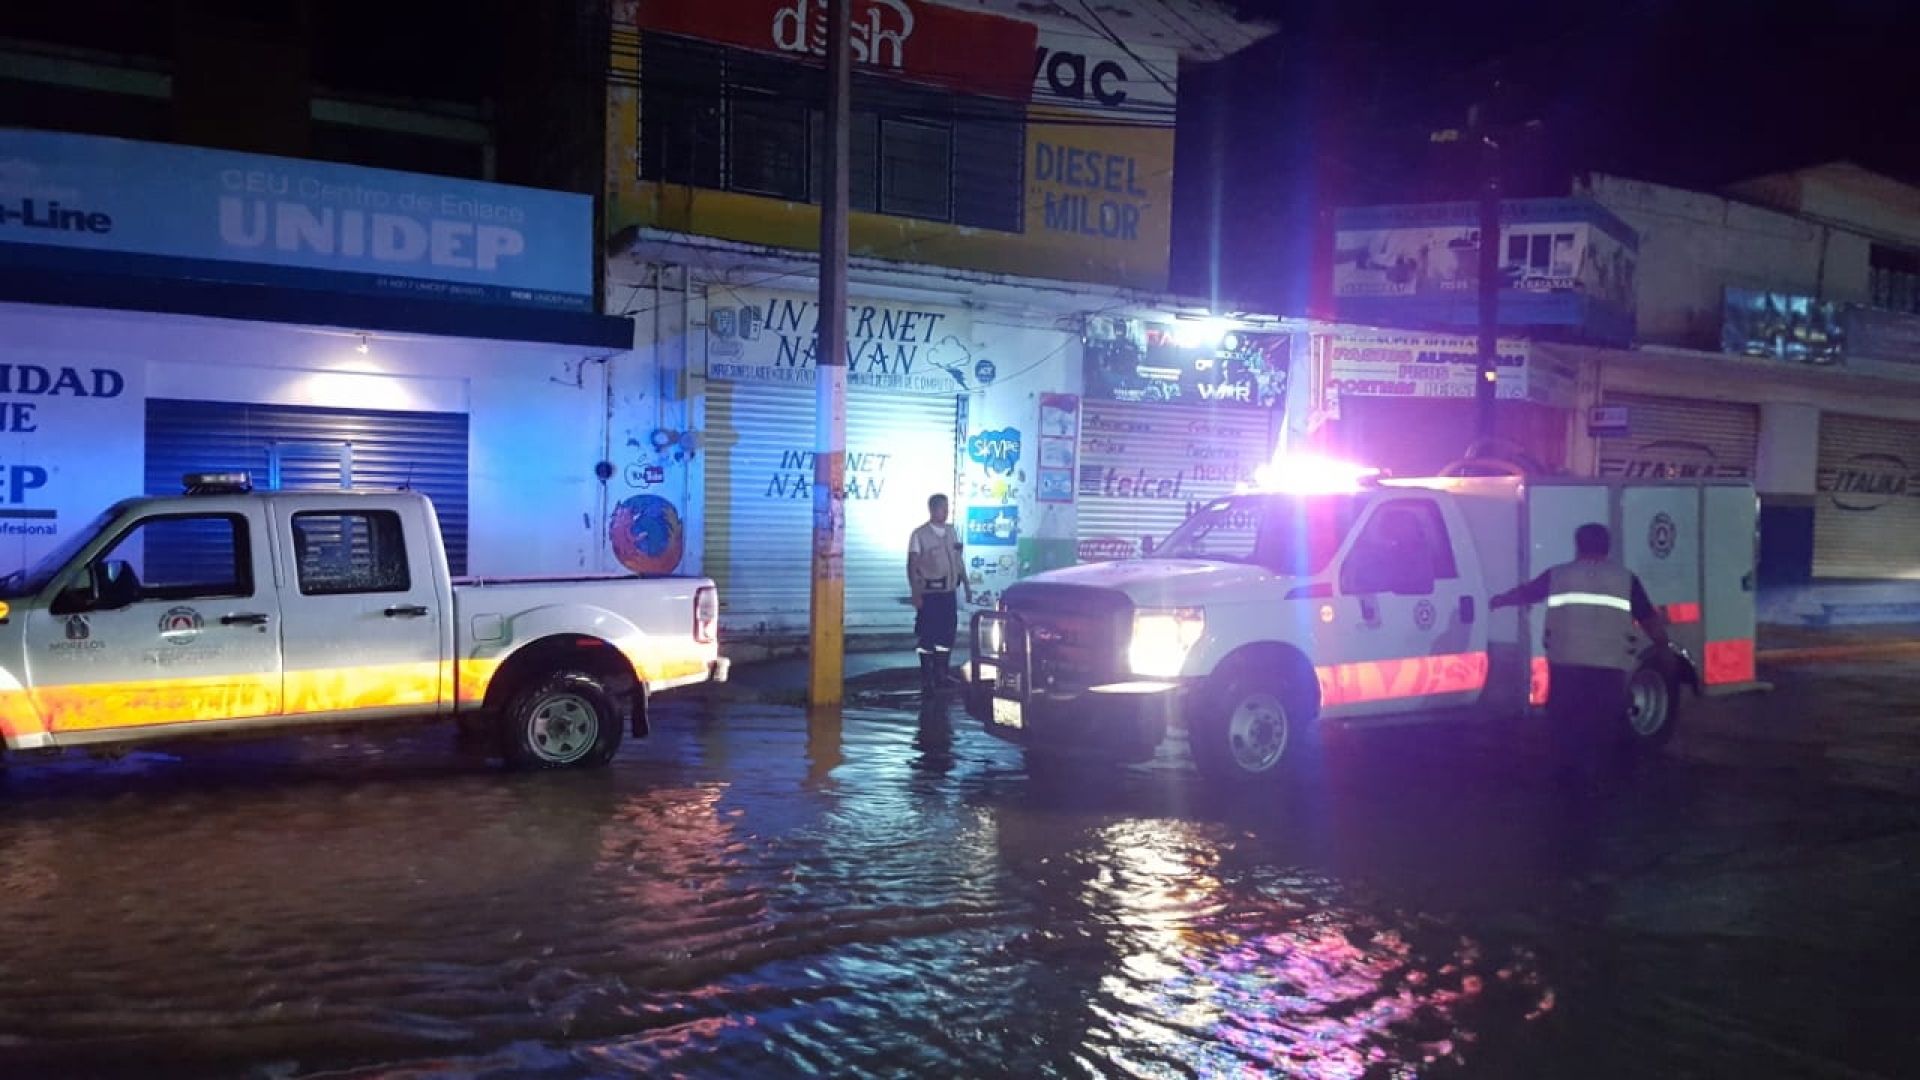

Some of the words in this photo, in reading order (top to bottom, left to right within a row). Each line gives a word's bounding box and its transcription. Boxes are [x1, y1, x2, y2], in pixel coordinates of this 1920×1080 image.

[1035, 141, 1147, 198] DIESEL
[221, 169, 289, 194] CEU
[299, 176, 390, 206] Centro
[398, 190, 433, 208] de
[441, 192, 526, 222] Enlace
[217, 196, 527, 272] UNIDEP
[763, 298, 945, 343] INRNET
[775, 335, 918, 375] NAVAN
[0, 362, 125, 399] IDAD
[780, 449, 892, 472] INTNET
[0, 464, 49, 504] P
[764, 473, 886, 500] NAAN
[980, 482, 1020, 505] Ggle
[1103, 467, 1183, 499] telcel
